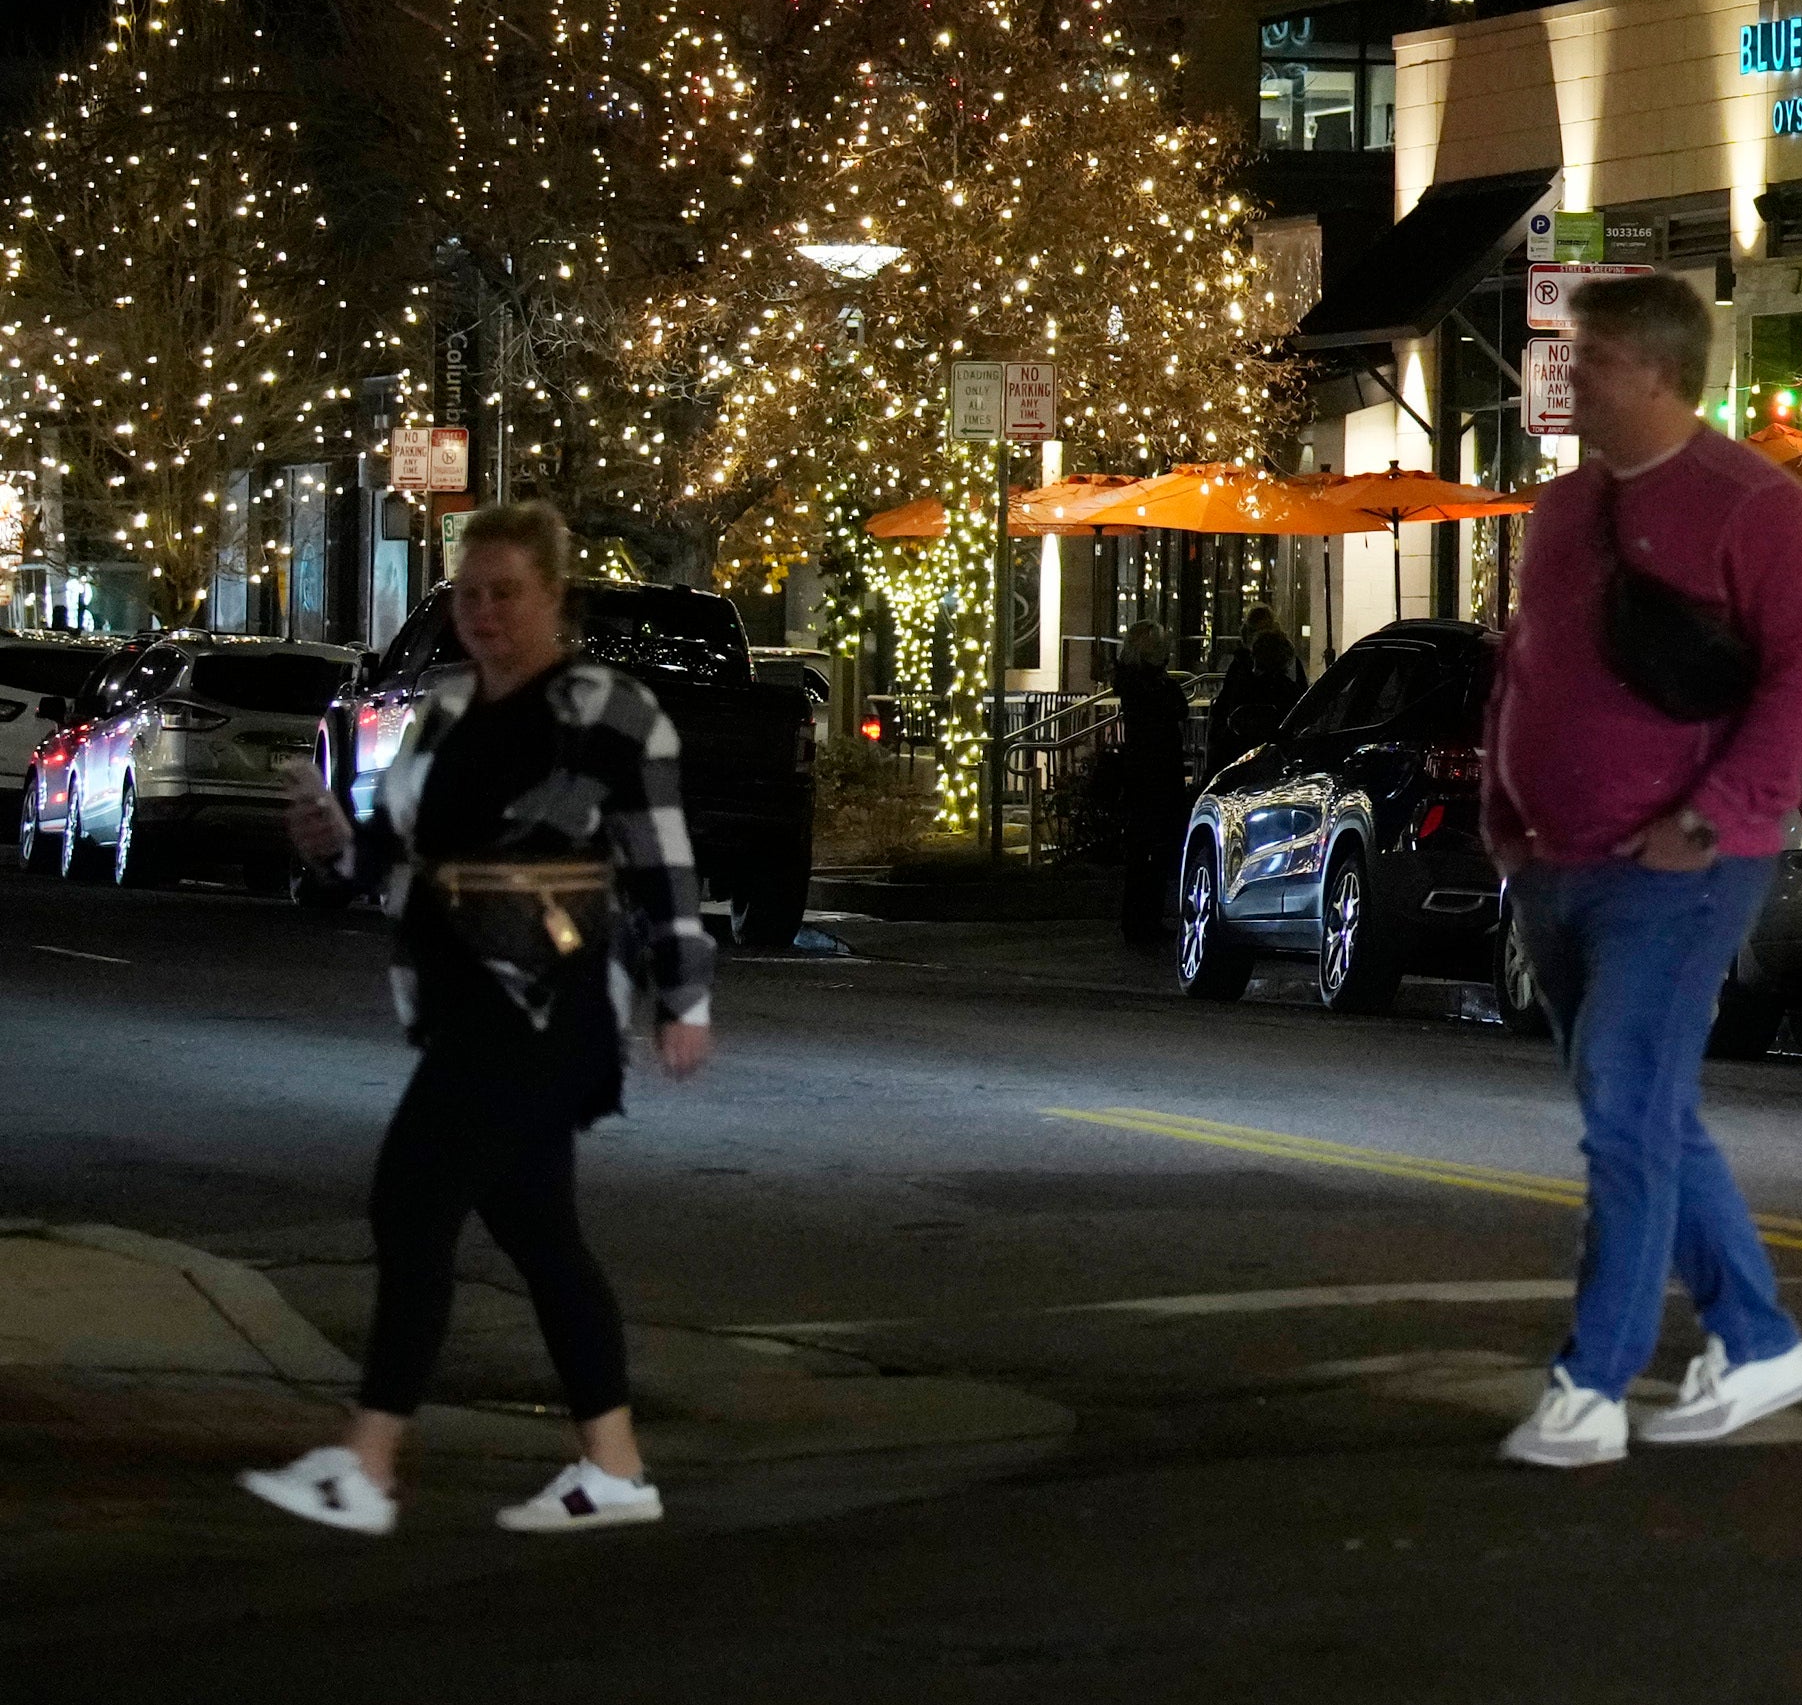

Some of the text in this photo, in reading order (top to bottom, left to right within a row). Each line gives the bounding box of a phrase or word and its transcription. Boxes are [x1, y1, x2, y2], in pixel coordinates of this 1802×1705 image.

[1740, 17, 1802, 74] BLUE
[1605, 227, 1652, 237] 3033166
[1549, 345, 1570, 362] NO
[957, 369, 999, 380] LOADING
[1021, 367, 1039, 381] NO
[1534, 364, 1572, 381] PARKI
[446, 334, 468, 423] Columb
[965, 386, 990, 395] ONLY
[1009, 383, 1051, 397] PARKING
[1547, 384, 1570, 395] ANY
[968, 400, 985, 411] ALL
[1021, 399, 1038, 408] ANY
[1547, 397, 1571, 408] TIME
[964, 415, 991, 425] TIMES
[1020, 410, 1039, 419] TIME
[404, 432, 418, 443] NO
[395, 445, 427, 457] PARKING
[445, 519, 454, 537] 3
